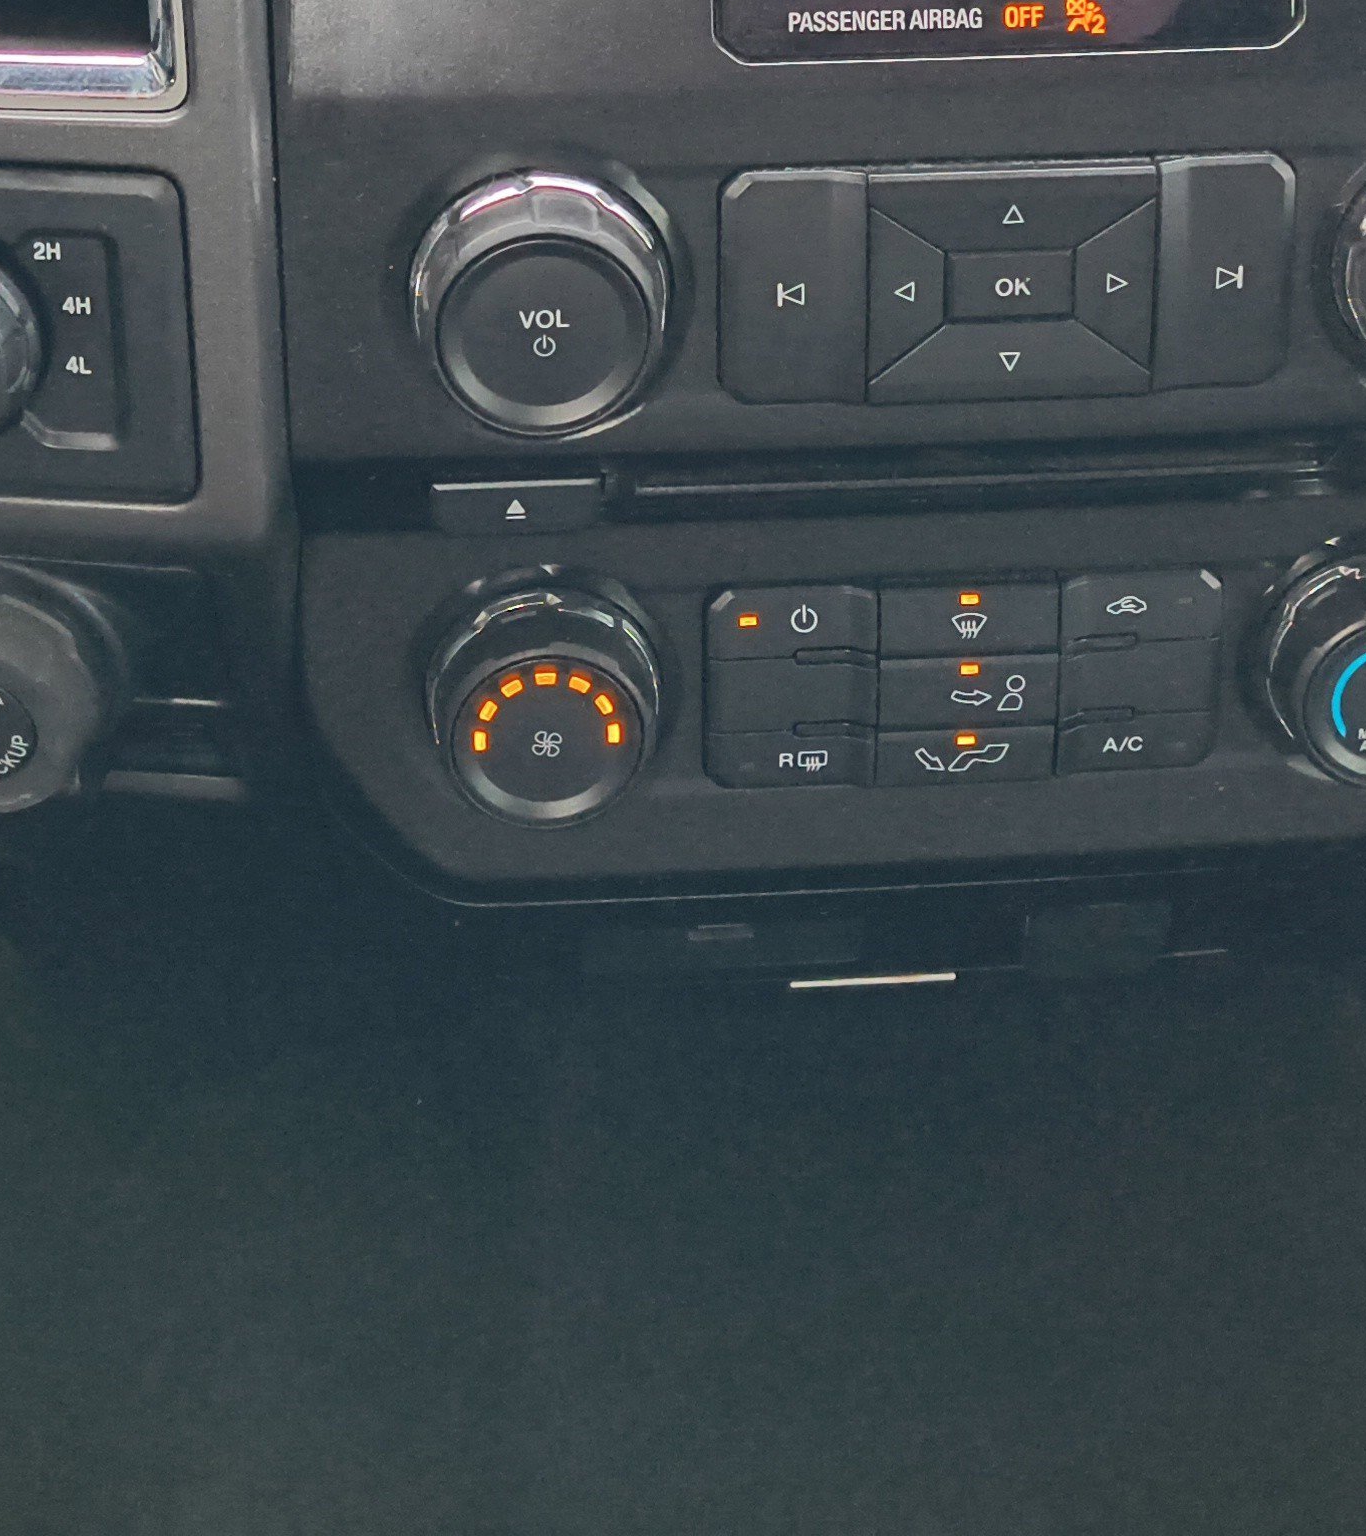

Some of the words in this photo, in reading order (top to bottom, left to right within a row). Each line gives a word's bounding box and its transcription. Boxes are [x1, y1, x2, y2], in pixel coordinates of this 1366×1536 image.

[787, 10, 907, 34] PASSENGER
[910, 7, 983, 30] AIRBAG
[1004, 5, 1045, 29] OFF
[33, 242, 62, 261] 2H
[995, 276, 1031, 297] OK
[62, 296, 92, 315] 4H
[519, 309, 571, 330] VOL
[65, 355, 92, 376] 4L
[1102, 735, 1144, 754] A/C
[779, 753, 794, 769] R
